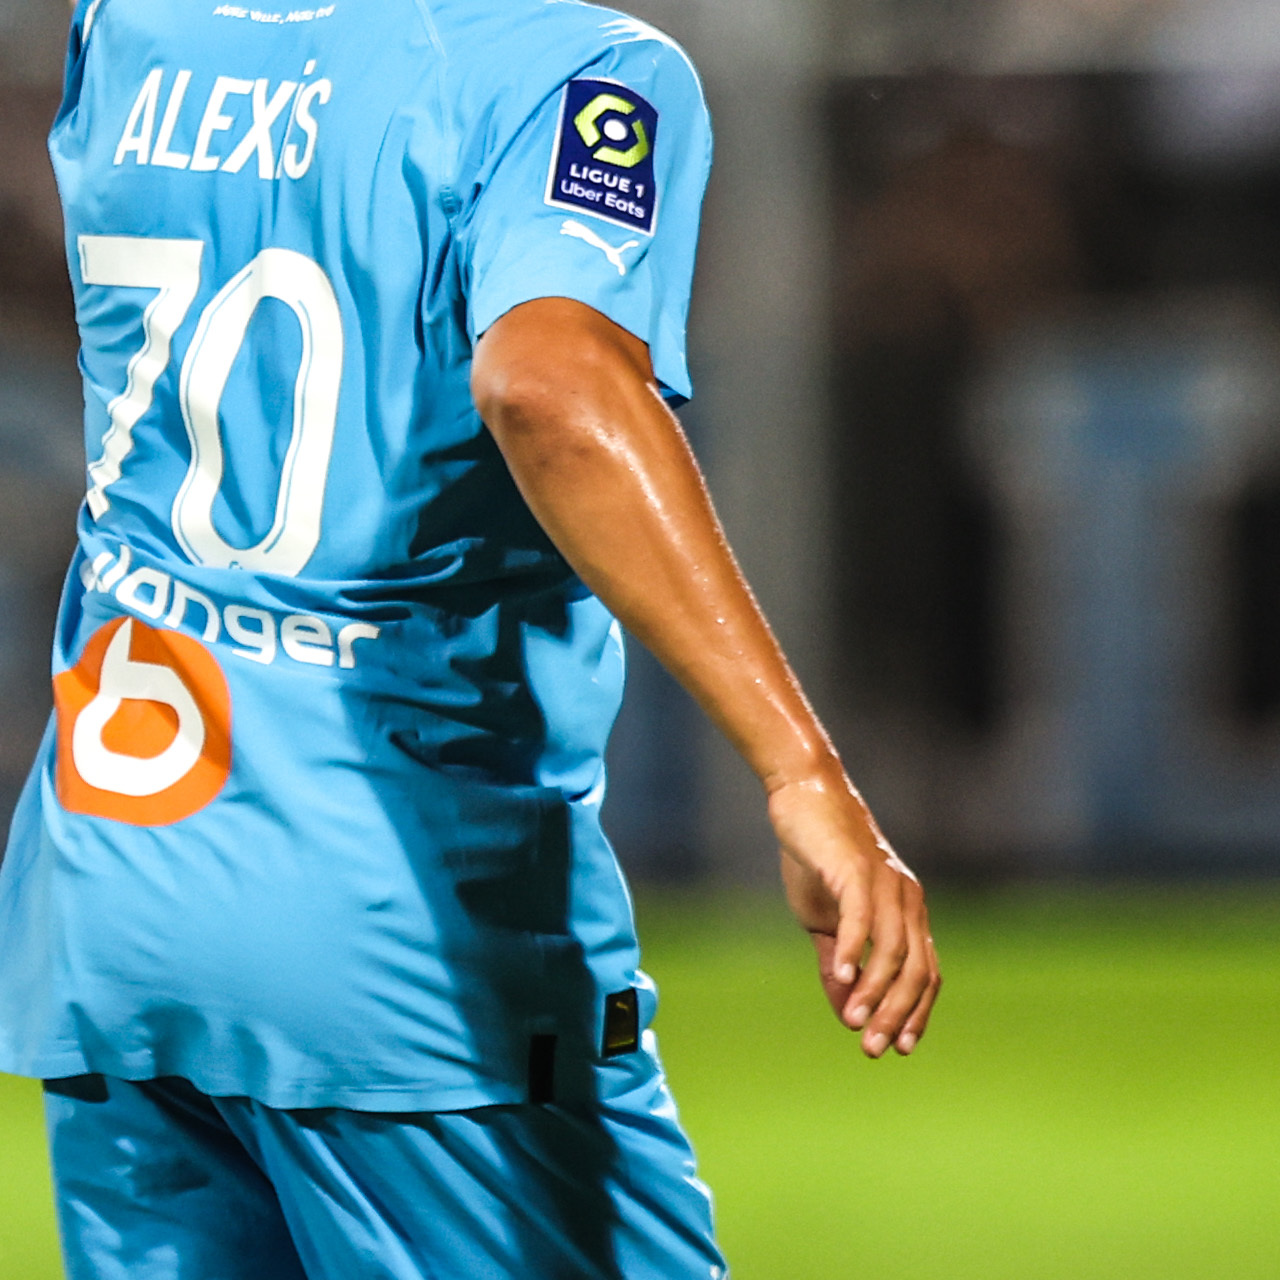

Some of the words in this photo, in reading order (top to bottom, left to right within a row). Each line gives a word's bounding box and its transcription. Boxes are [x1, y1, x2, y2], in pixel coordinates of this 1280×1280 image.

[560, 179, 603, 202] Uber
[604, 193, 645, 218] Eats
[569, 163, 631, 193] LIGUE
[635, 183, 645, 199] 1
[77, 235, 344, 579] 70
